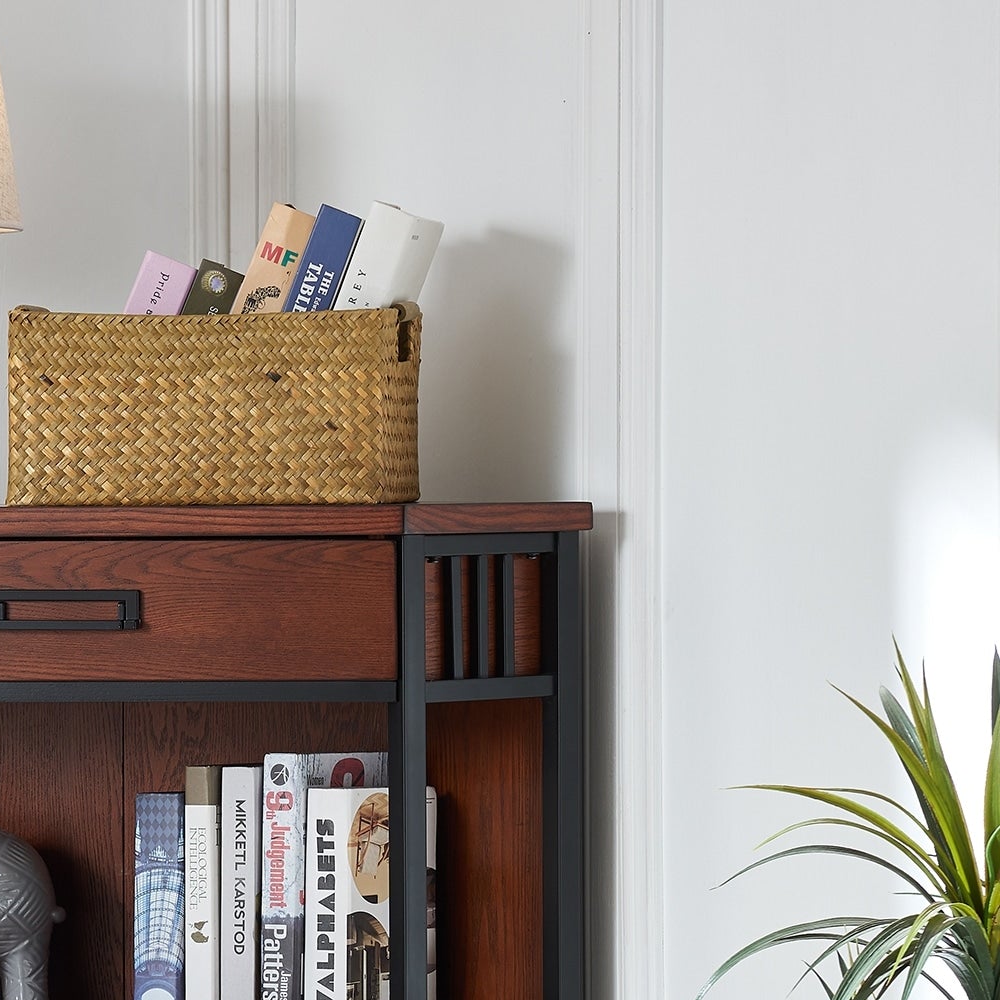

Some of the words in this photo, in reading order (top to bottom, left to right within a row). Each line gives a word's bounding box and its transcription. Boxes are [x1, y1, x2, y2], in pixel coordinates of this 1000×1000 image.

[260, 241, 298, 267] MF
[317, 271, 335, 296] THE
[234, 799, 247, 871] MIKKETL
[266, 822, 291, 909] Judgement
[233, 876, 246, 955] KARSTOD
[315, 818, 336, 993] ALPHABETS
